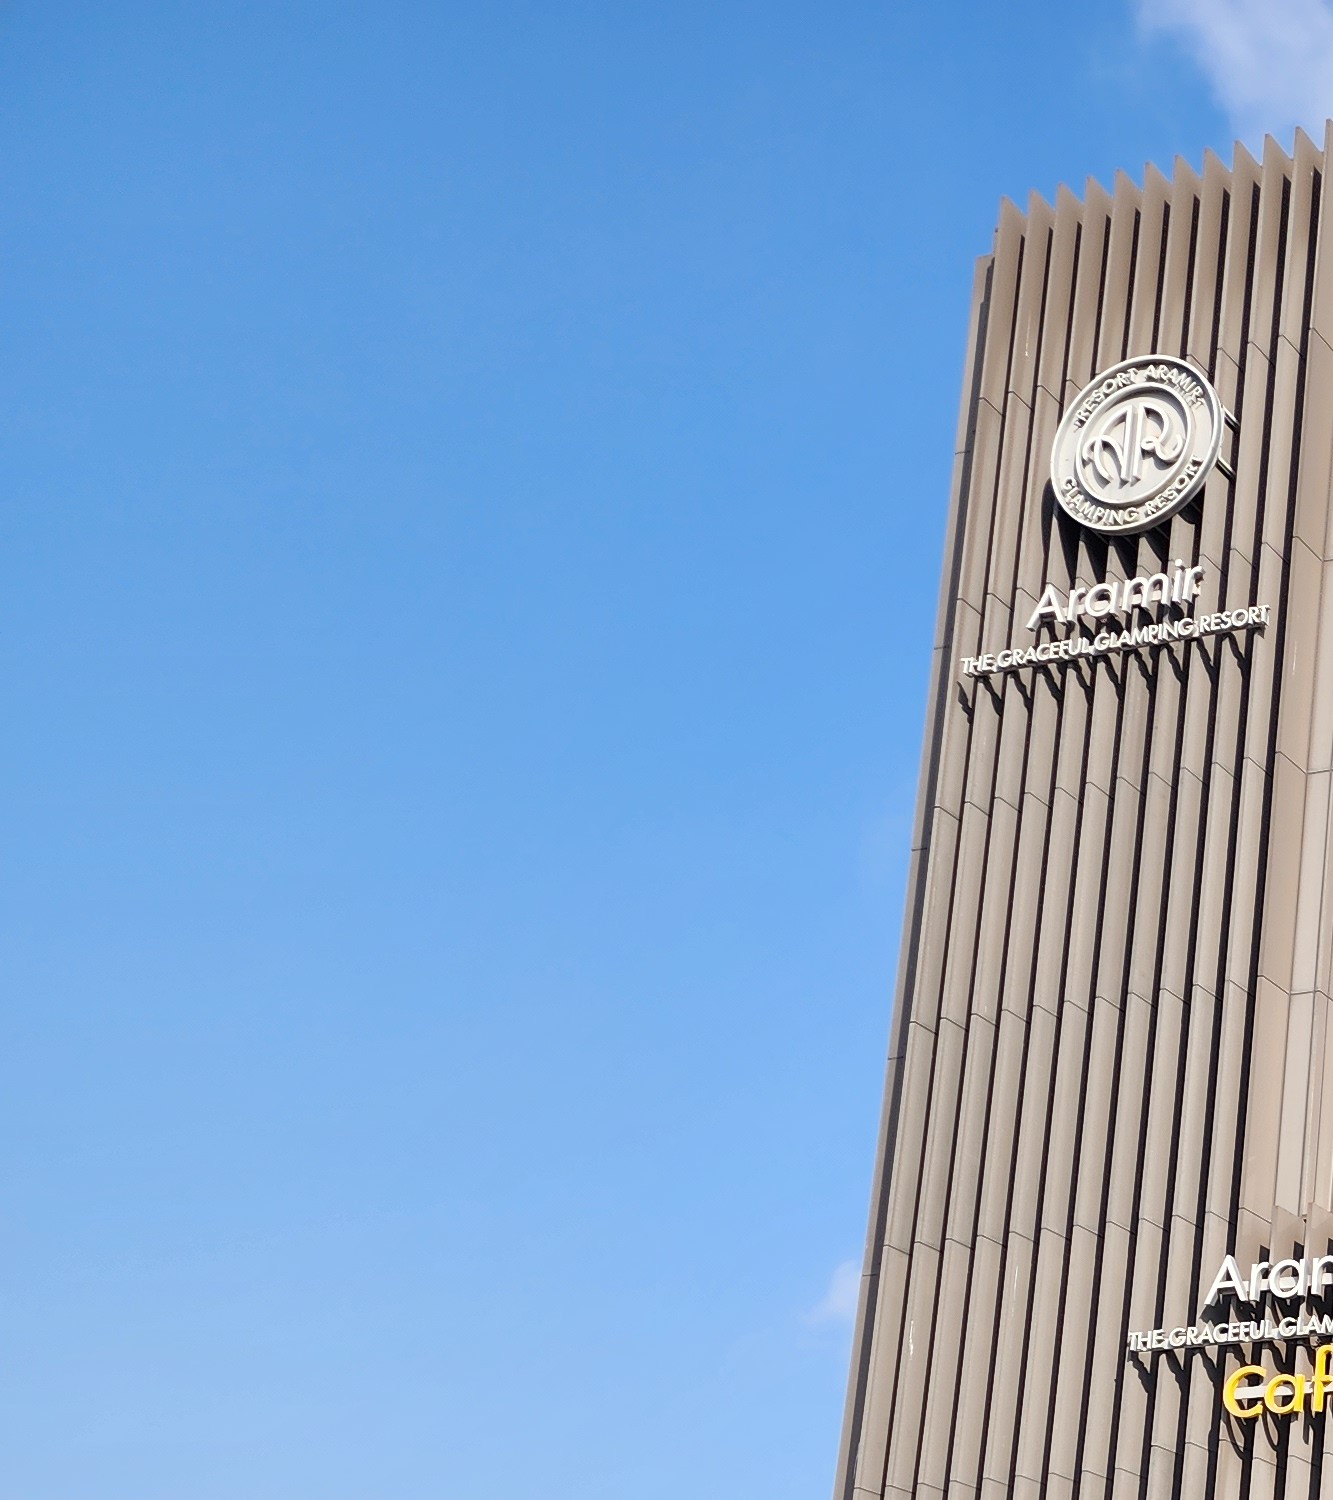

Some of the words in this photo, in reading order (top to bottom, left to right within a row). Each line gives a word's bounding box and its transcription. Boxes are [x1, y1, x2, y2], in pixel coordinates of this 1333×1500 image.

[1077, 367, 1138, 427] RESORT
[1143, 364, 1206, 406] ARAMIR
[1062, 475, 1140, 526] GLAMPING
[1144, 454, 1204, 516] RESORT
[1025, 558, 1206, 632] Aramir
[961, 655, 998, 677] THE
[996, 637, 1094, 669] GRACEFUL
[1093, 617, 1196, 652] GLAMPING
[1197, 604, 1271, 634] RESORT
[1128, 1329, 1169, 1352] THE
[1169, 1318, 1279, 1348] GRACEFUL
